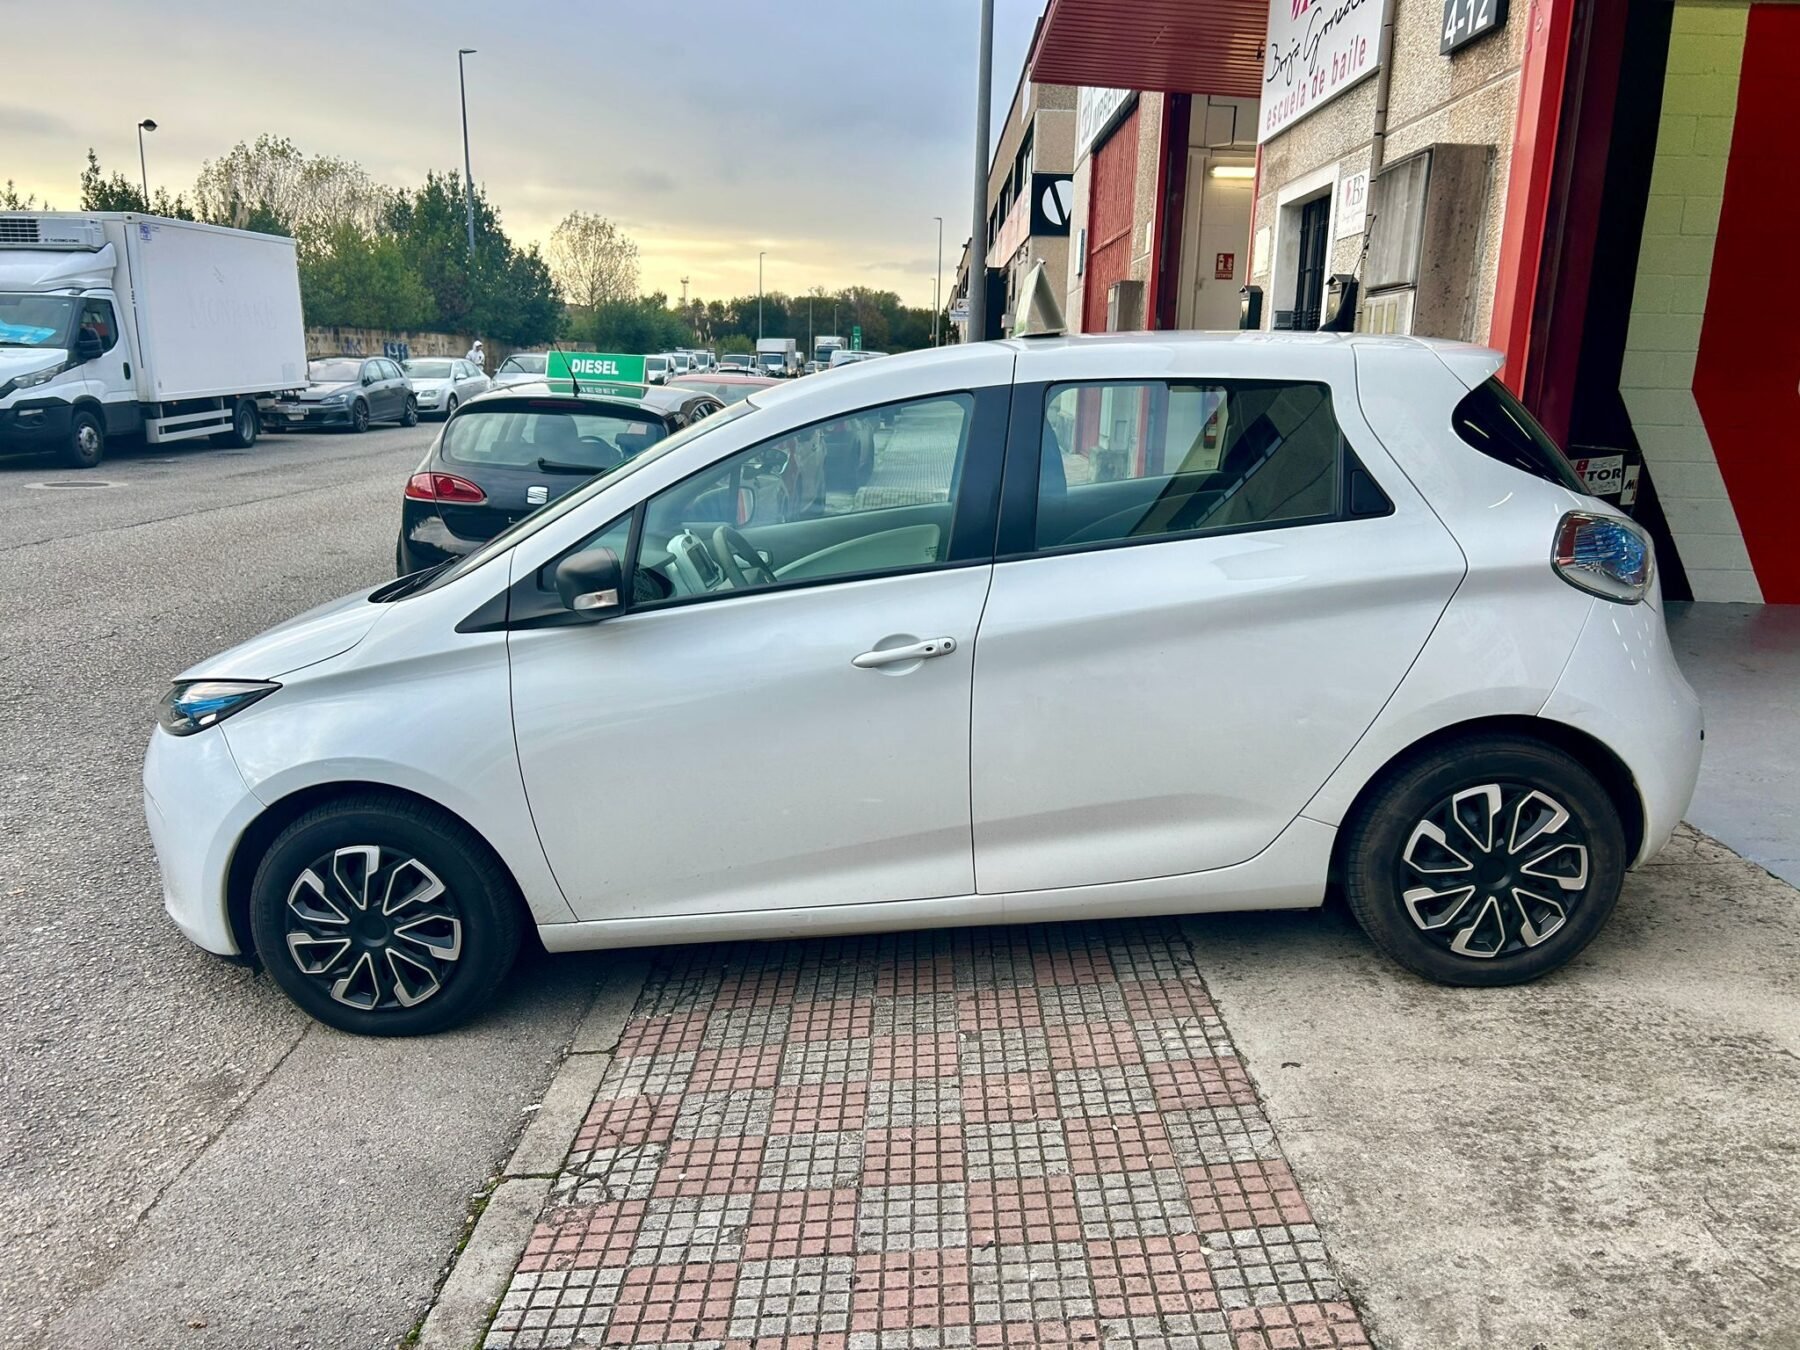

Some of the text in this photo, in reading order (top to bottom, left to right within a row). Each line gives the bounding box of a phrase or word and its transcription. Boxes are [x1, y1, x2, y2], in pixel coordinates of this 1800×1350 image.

[1444, 0, 1488, 45] 4-12
[1266, 34, 1366, 131] escuela de baile
[571, 358, 619, 375] DIESEL
